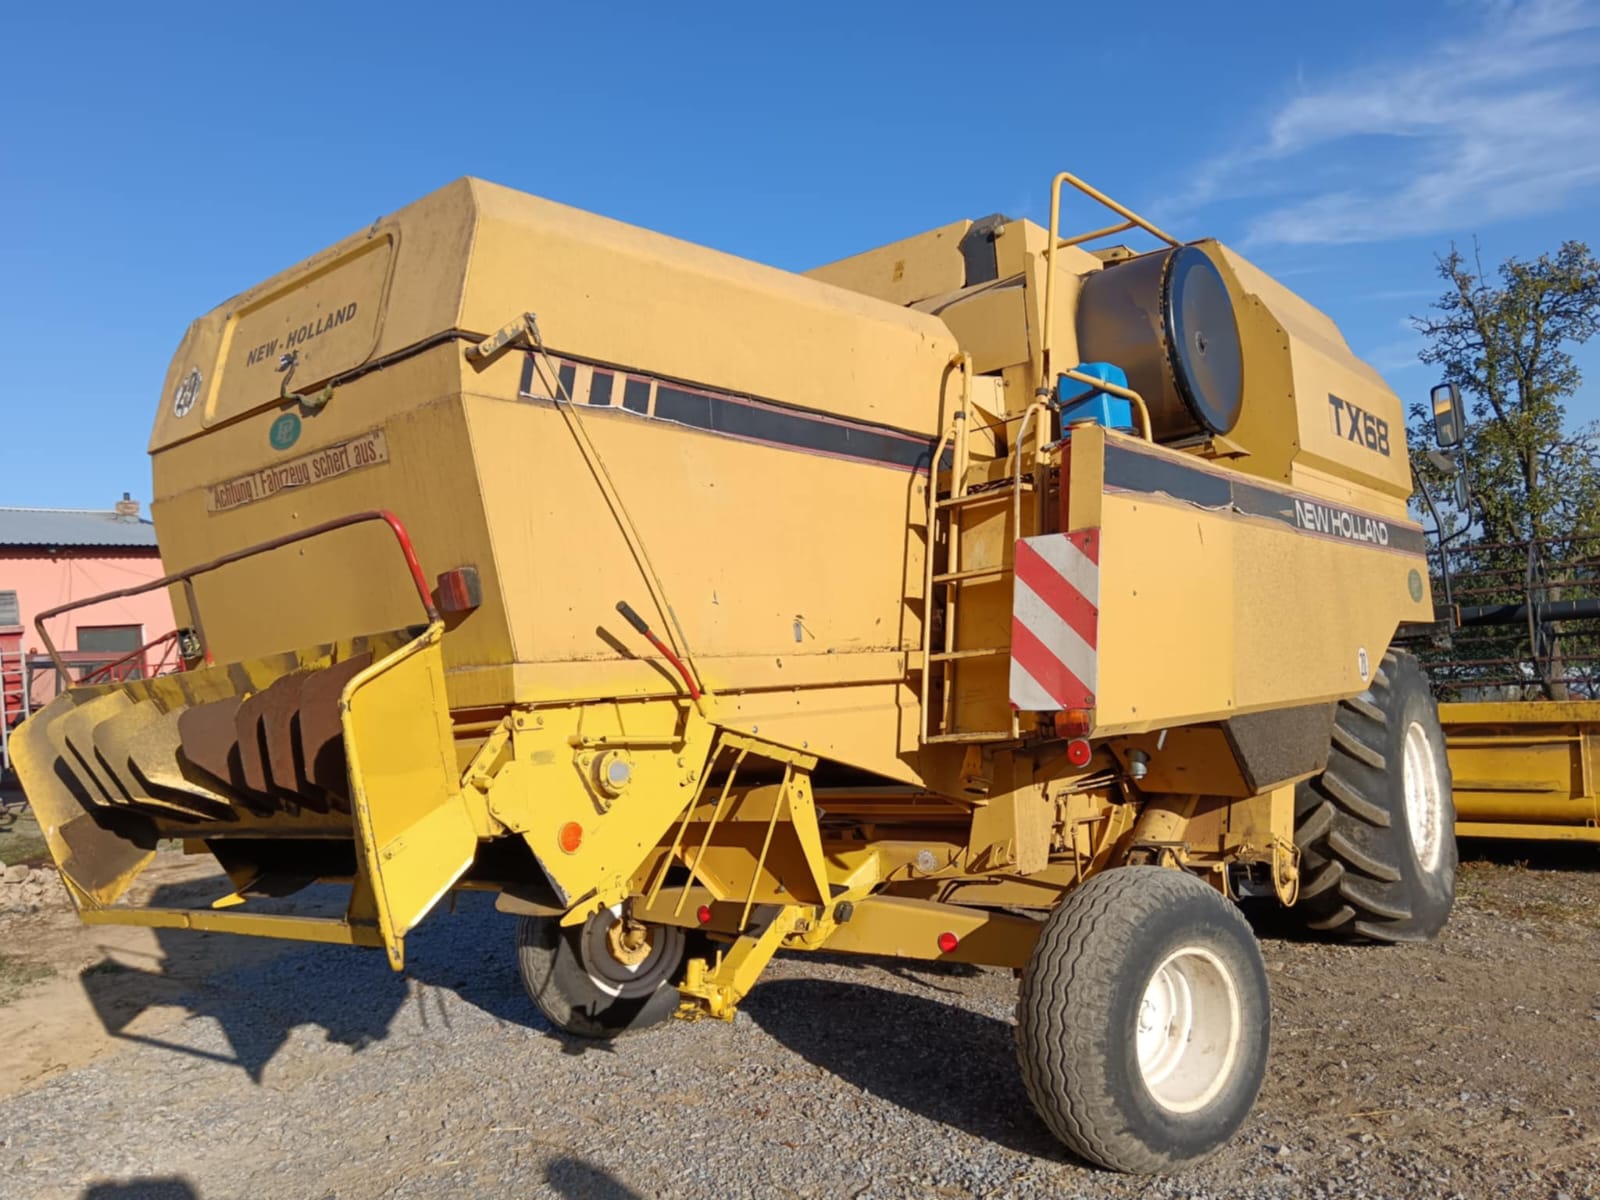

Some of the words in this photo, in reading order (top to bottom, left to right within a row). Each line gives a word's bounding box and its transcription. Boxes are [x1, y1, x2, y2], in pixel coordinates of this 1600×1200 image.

[286, 302, 357, 349] HOLLAND
[1328, 393, 1391, 457] TX68
[260, 463, 311, 495] Fahrzeug
[313, 446, 351, 478] schert
[1295, 500, 1329, 533] NEW
[1331, 509, 1388, 545] HOLLAND
